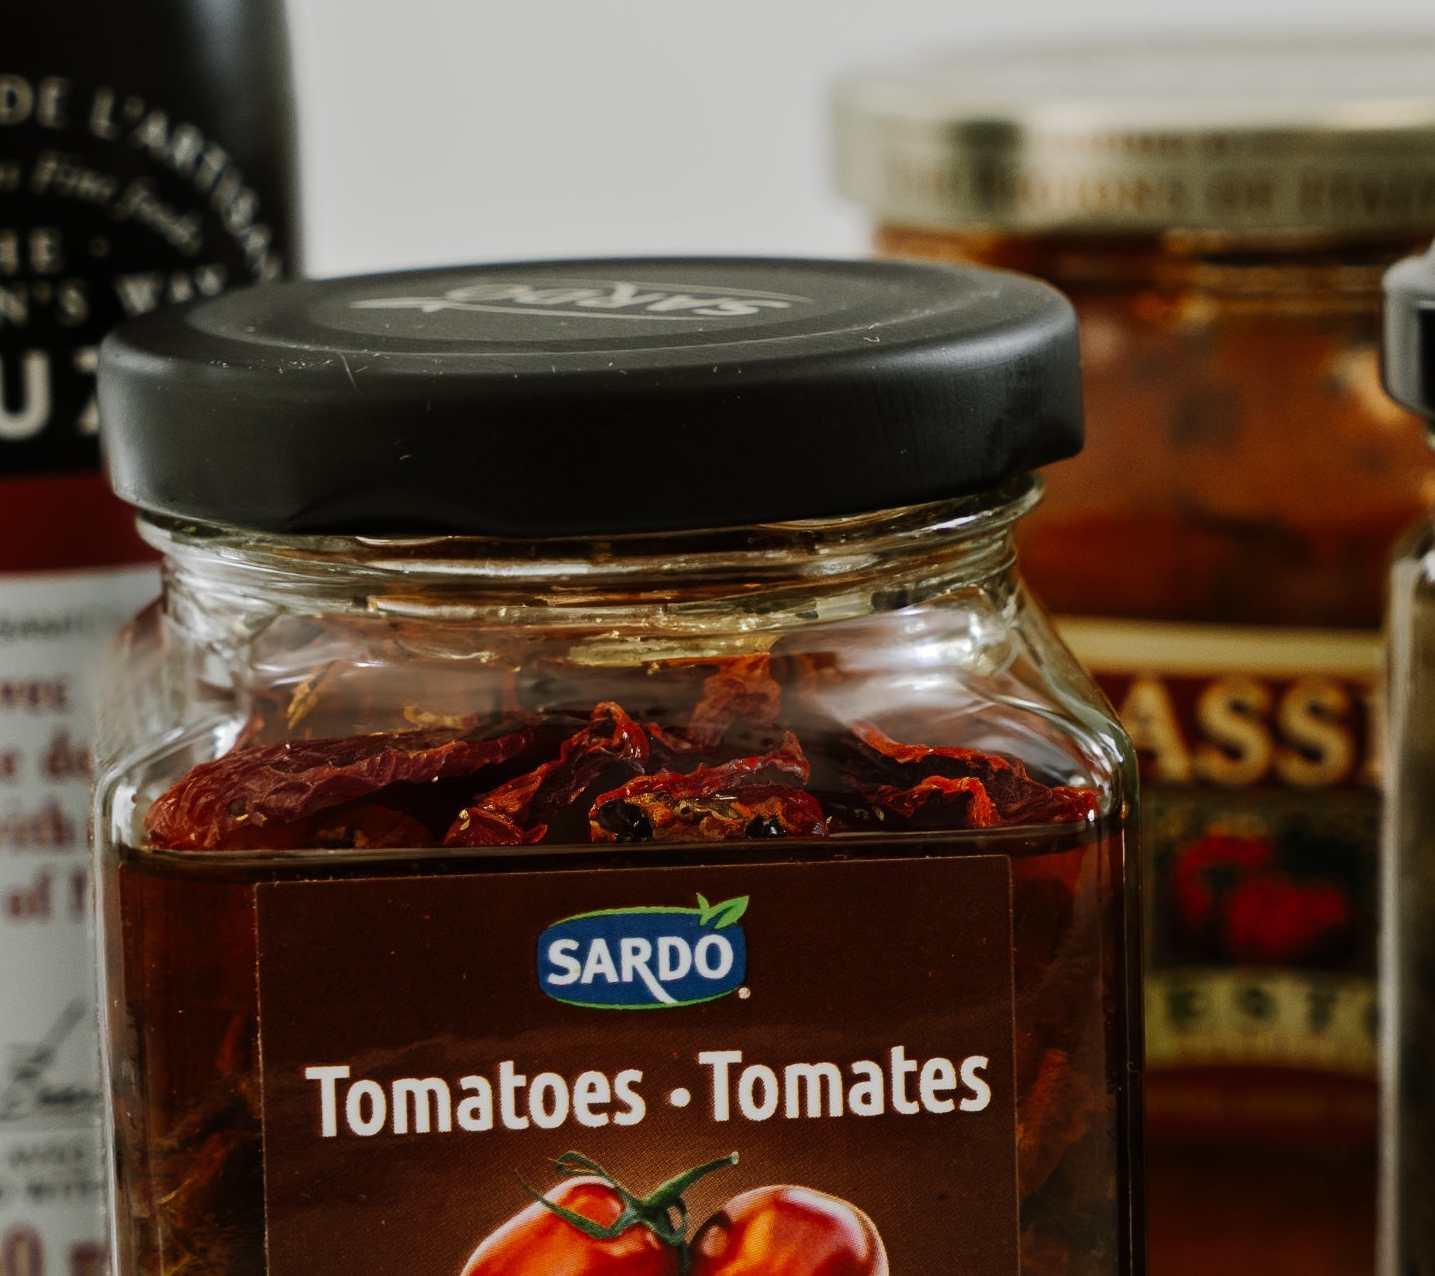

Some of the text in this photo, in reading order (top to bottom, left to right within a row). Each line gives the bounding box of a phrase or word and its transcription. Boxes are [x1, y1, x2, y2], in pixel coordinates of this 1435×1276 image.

[547, 934, 734, 1004] SARDO
[305, 1046, 992, 1138] Tomatoes Tomates
